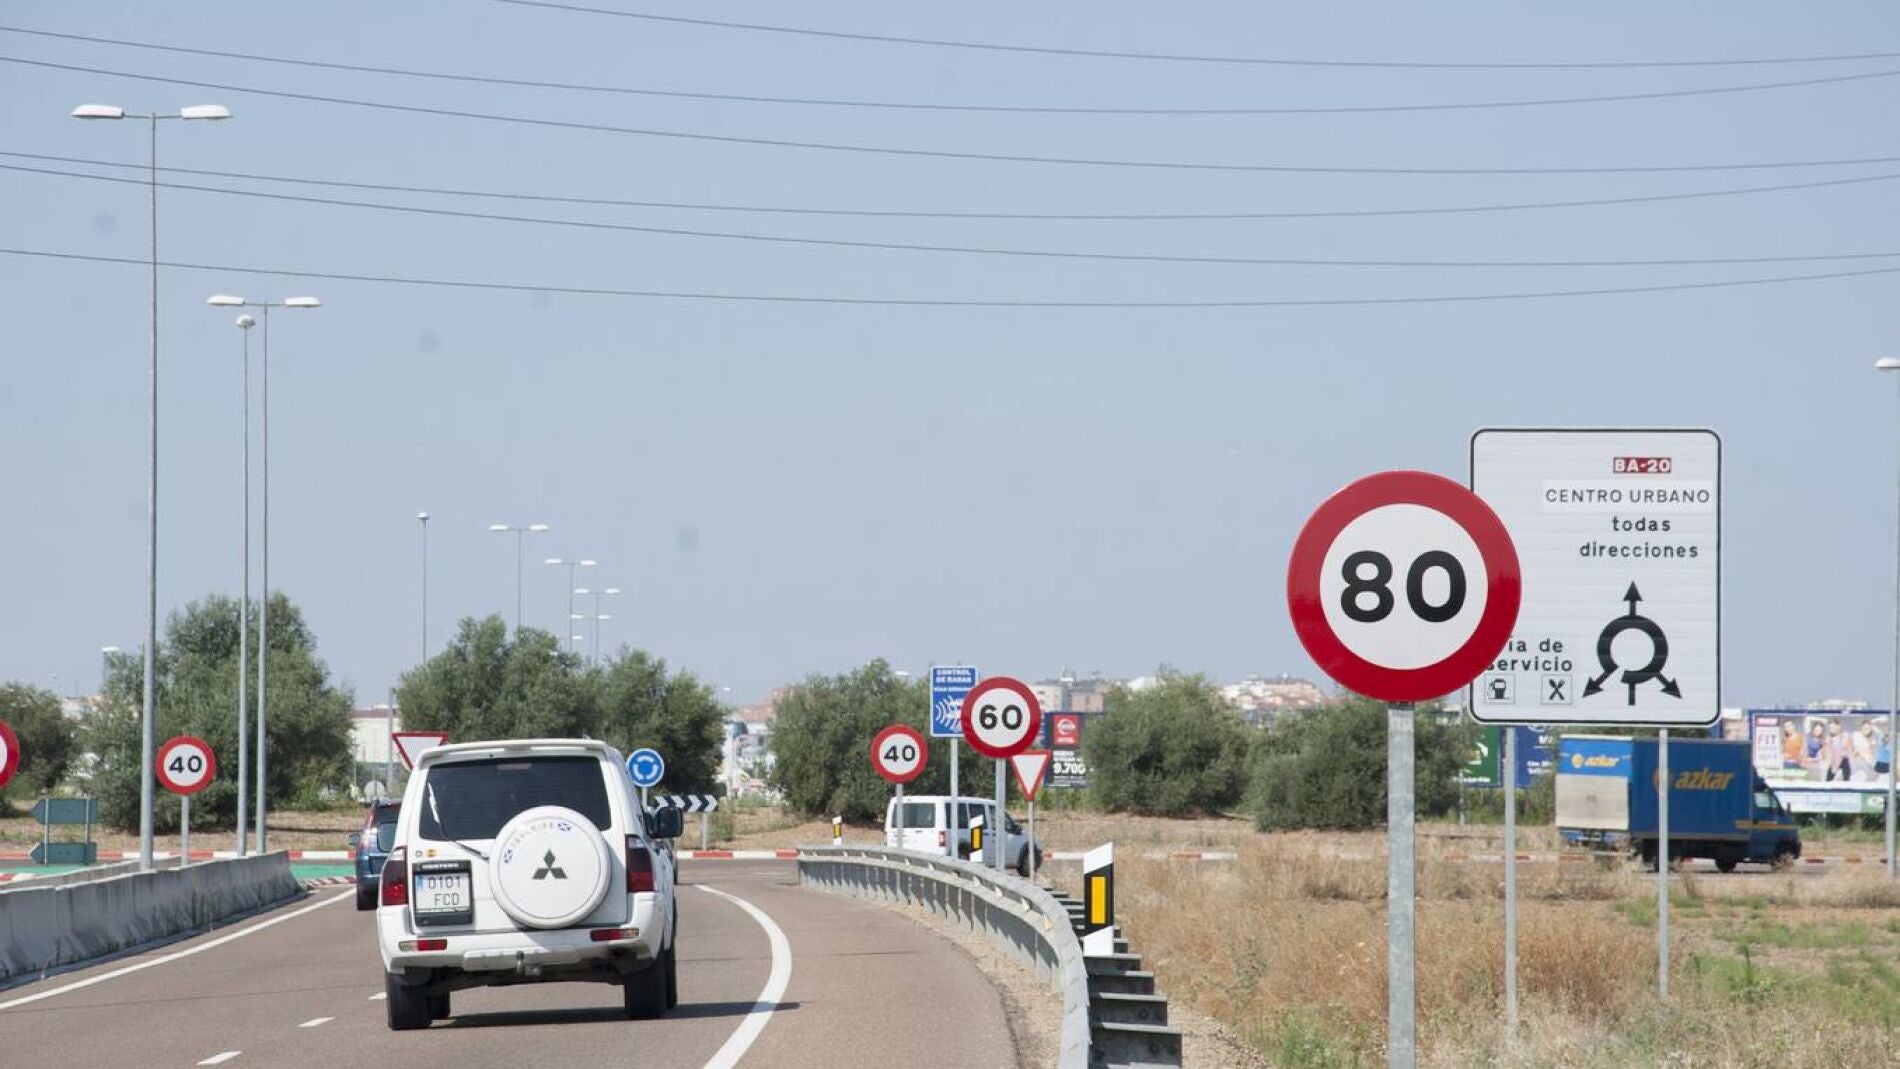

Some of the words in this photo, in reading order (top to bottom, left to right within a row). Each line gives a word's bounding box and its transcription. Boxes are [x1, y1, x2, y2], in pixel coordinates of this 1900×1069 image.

[1614, 458, 1671, 473] BA-20
[1546, 489, 1622, 503] CENTRO
[1630, 489, 1711, 503] URBANO
[1612, 516, 1671, 532] todas
[1579, 542, 1699, 558] direcciones
[1340, 550, 1467, 623] 80
[1508, 634, 1527, 653] ía
[1539, 638, 1563, 653] de
[979, 704, 1023, 730] 60
[884, 744, 916, 762] 40
[1584, 754, 1620, 767] azkar
[169, 755, 202, 773] 40
[1674, 767, 1735, 790] azkar
[428, 876, 461, 889] 0101
